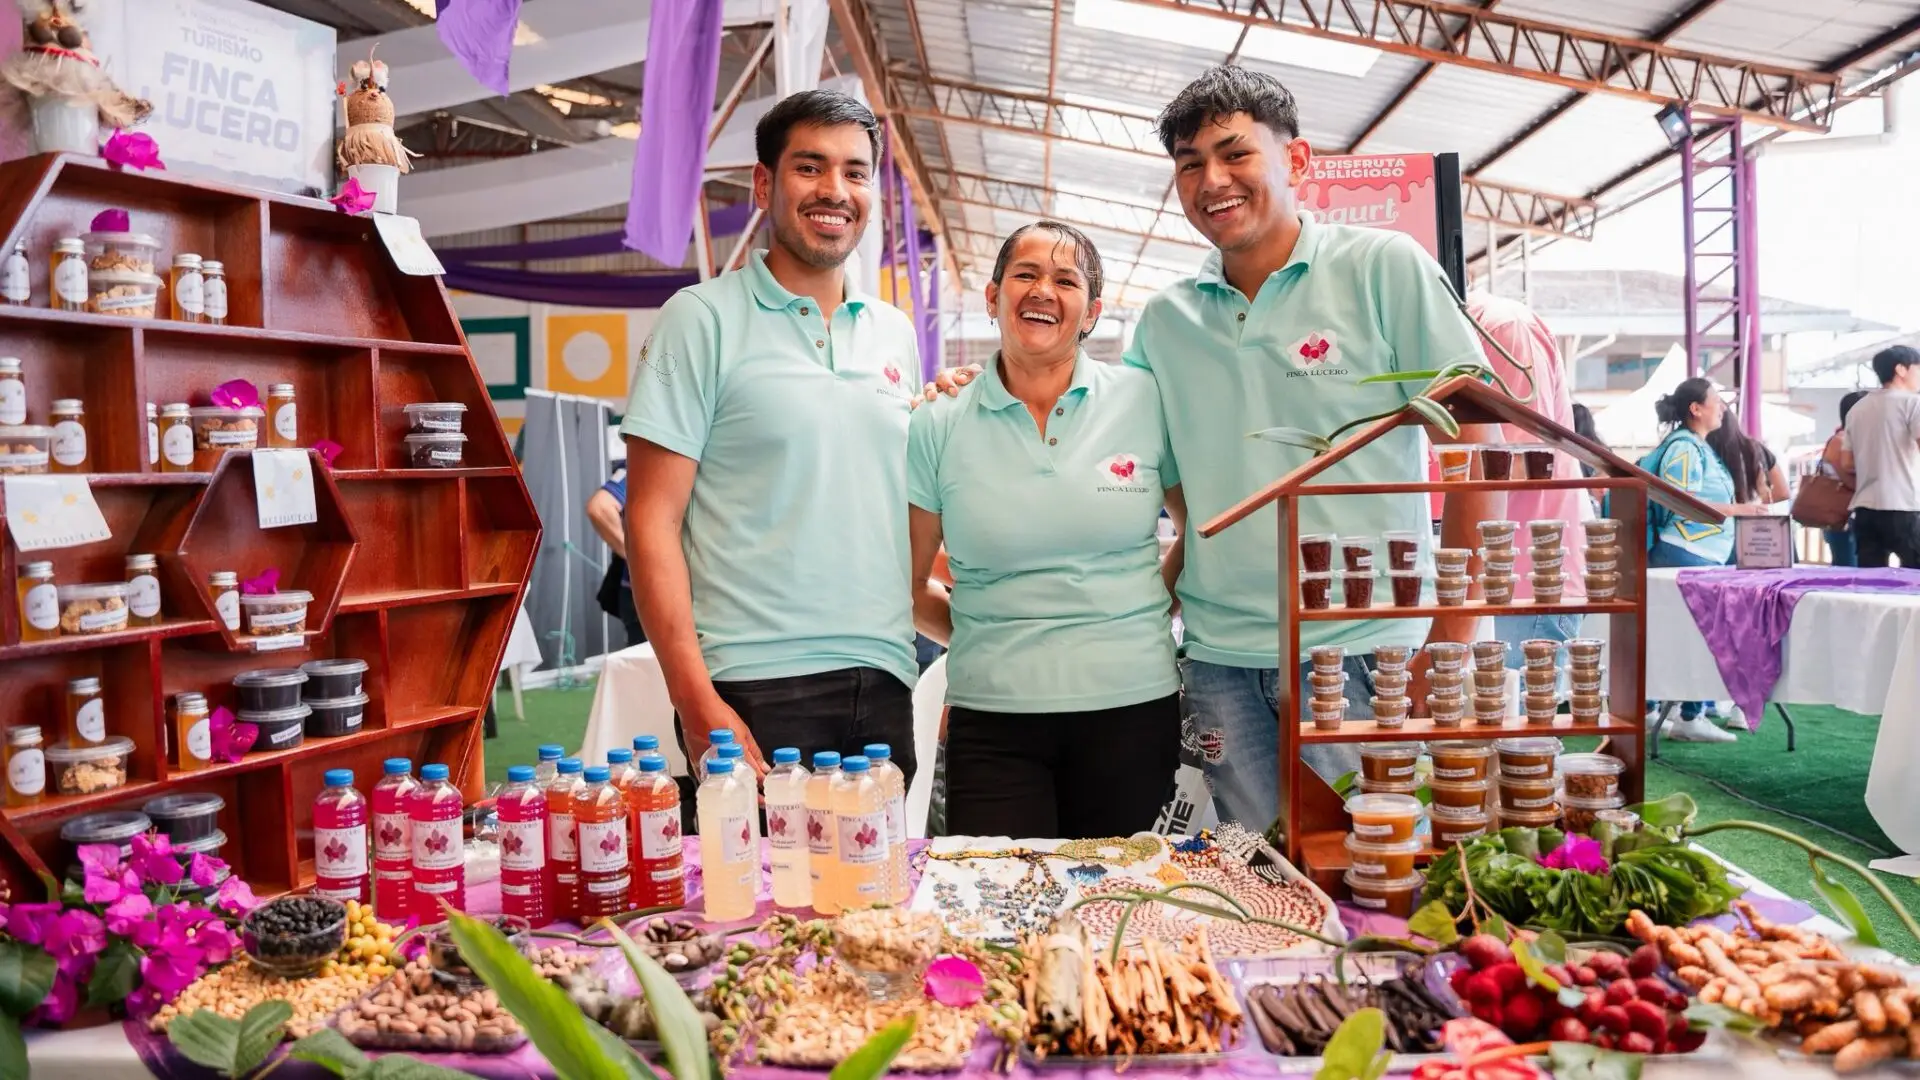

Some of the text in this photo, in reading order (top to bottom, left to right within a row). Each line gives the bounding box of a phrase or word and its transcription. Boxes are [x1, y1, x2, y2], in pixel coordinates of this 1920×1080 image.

[180, 26, 263, 63] TURISMO
[161, 51, 279, 112] FINCA
[141, 85, 300, 152] LUCERO
[1311, 158, 1407, 169] Y DISFRUTA
[1314, 167, 1405, 179] DELICIOSO
[1300, 197, 1400, 226] ogurt
[1286, 368, 1349, 378] FINCA LUCERO
